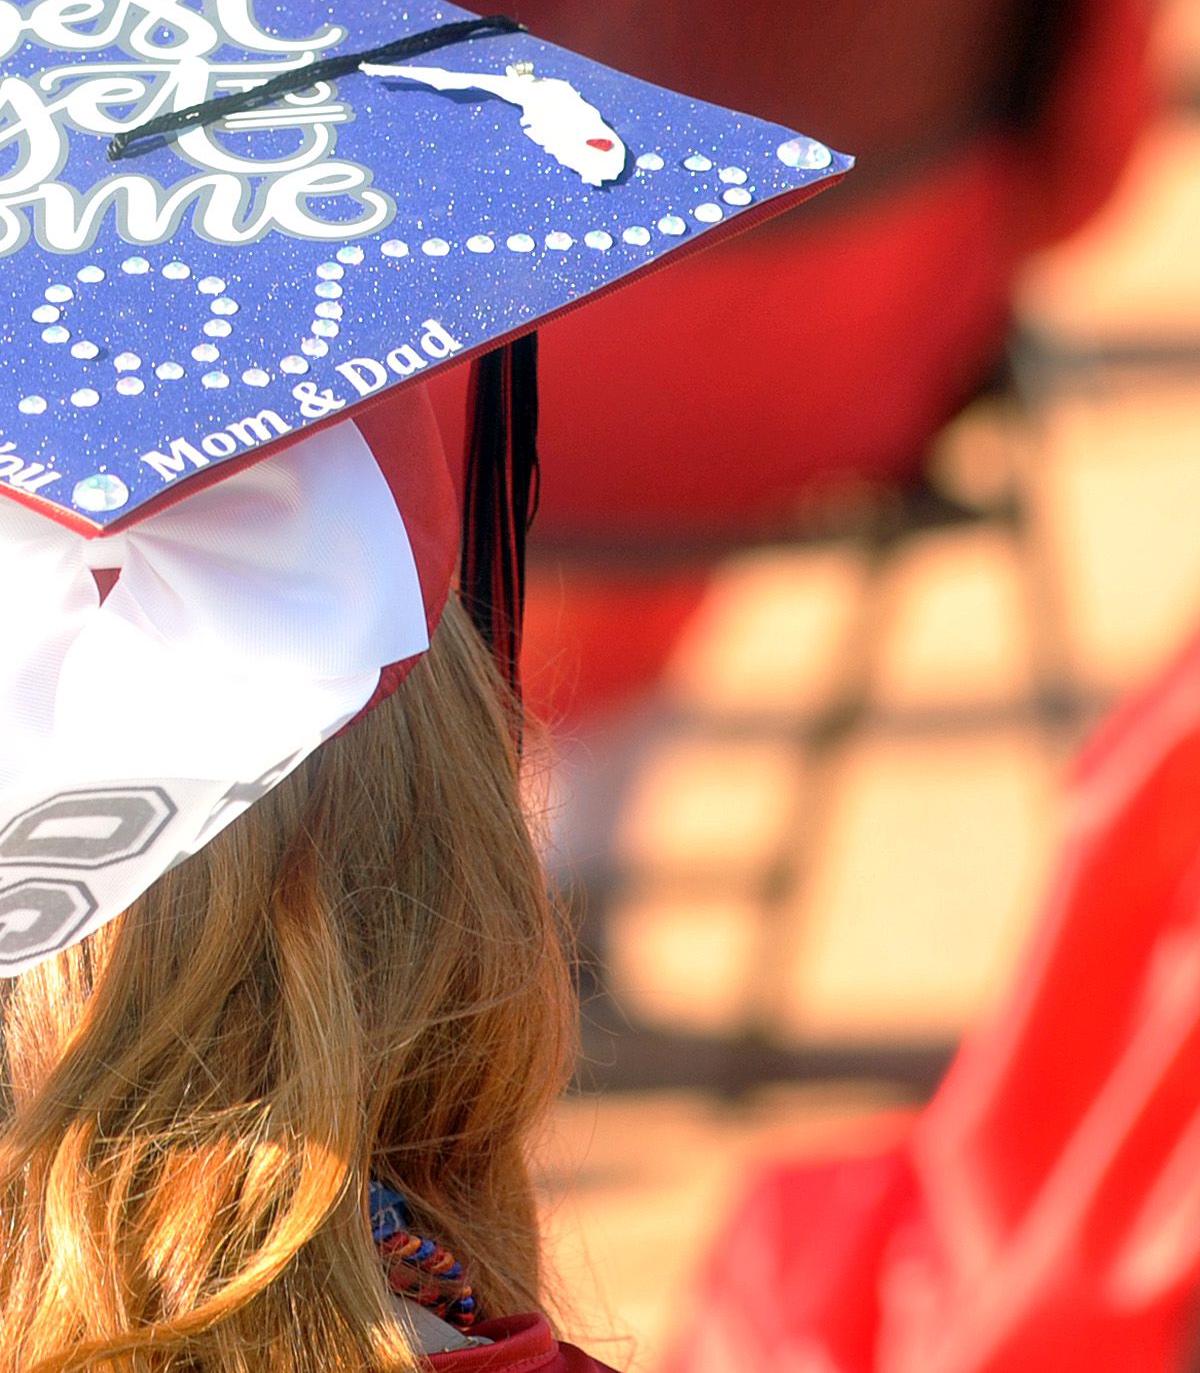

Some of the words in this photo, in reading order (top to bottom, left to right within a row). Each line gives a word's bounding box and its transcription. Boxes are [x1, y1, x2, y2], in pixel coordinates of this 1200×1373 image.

[141, 409, 292, 482] Mom
[292, 381, 346, 418] &
[335, 319, 463, 397] Dad
